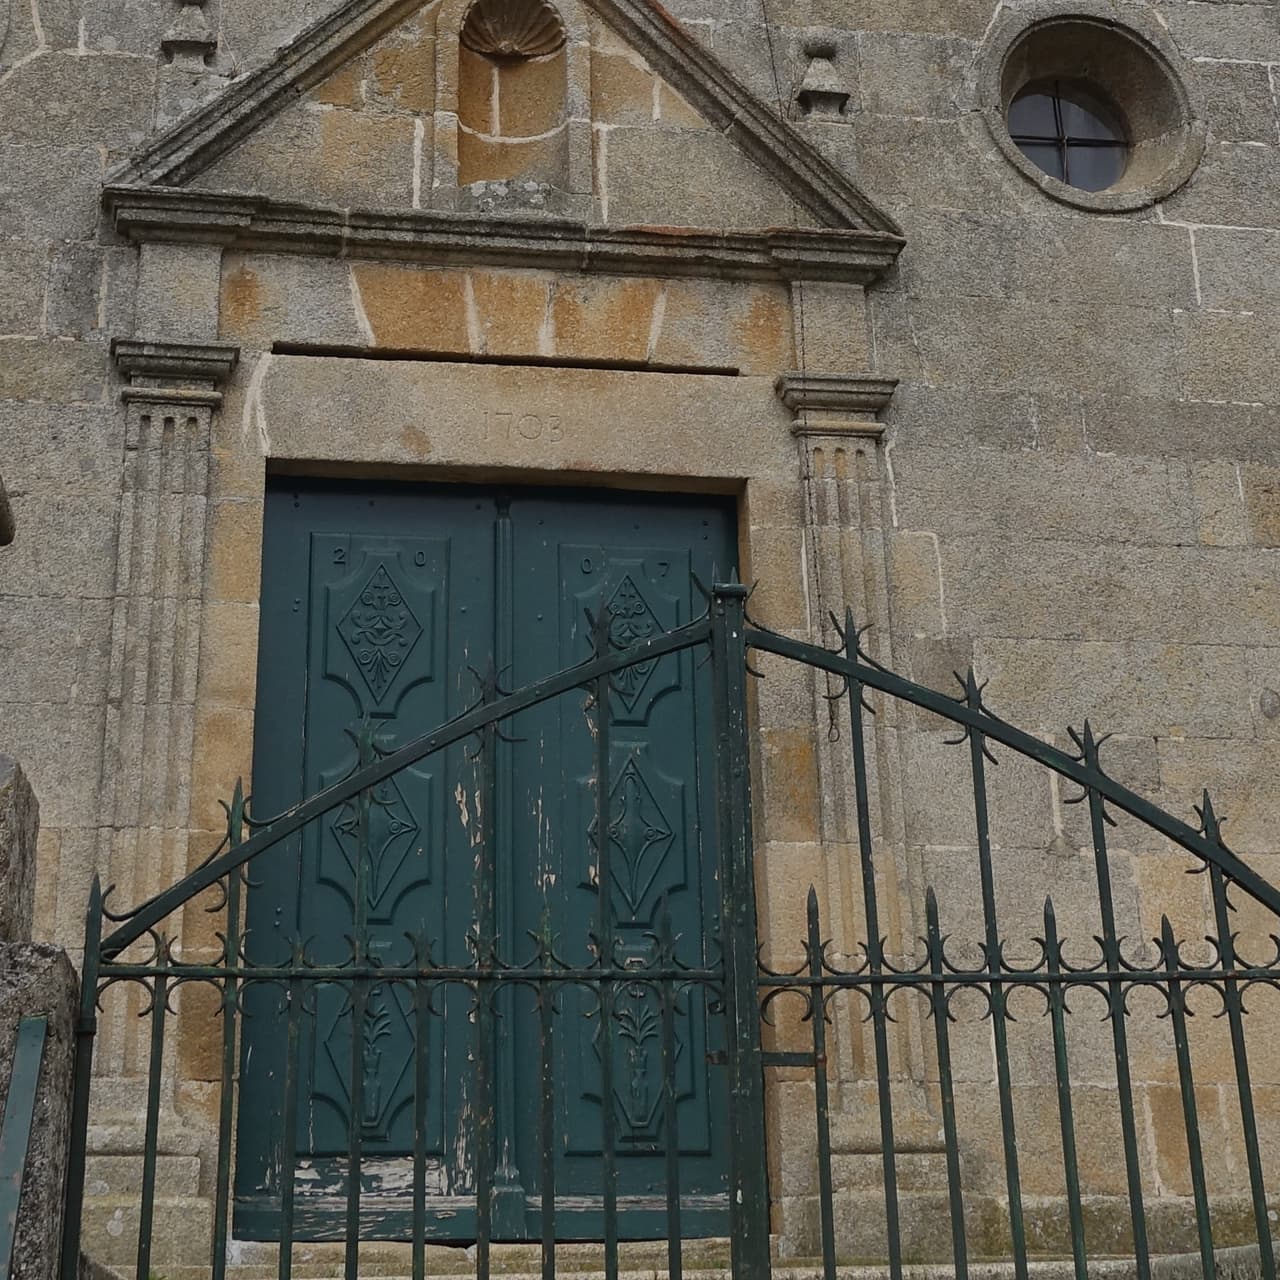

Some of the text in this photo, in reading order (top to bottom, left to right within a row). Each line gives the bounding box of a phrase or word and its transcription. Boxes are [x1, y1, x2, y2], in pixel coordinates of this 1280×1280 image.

[482, 409, 564, 443] 1703
[332, 547, 670, 578] 2 0 0 7
